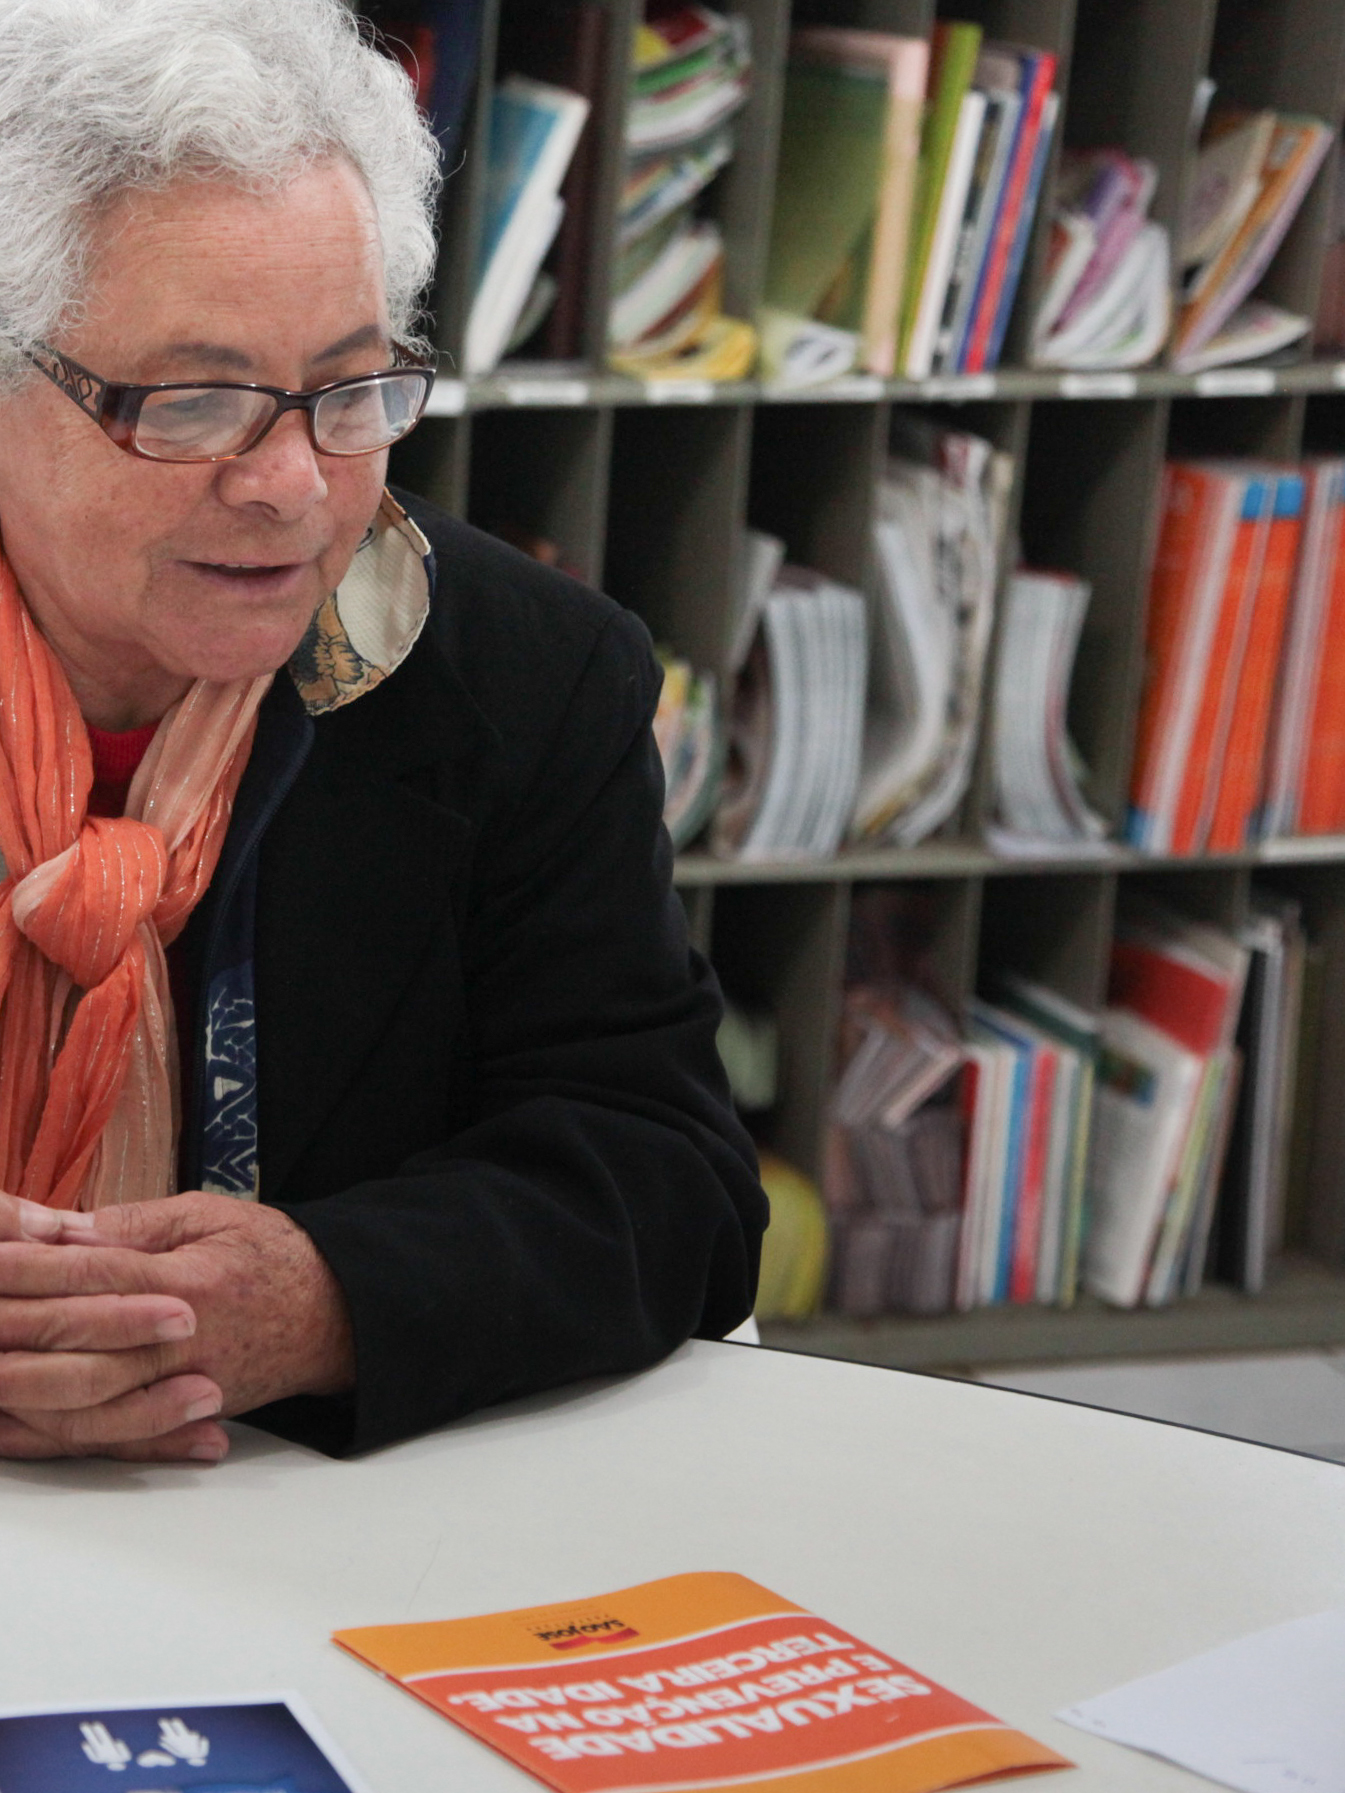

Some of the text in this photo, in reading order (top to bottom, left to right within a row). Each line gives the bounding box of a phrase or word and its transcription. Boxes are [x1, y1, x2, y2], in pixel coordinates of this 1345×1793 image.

[446, 1632, 856, 1712] TERCEIRA IDADE.
[494, 1654, 893, 1734] E PREVENÇÃO NA
[528, 1675, 932, 1761] SEXUALIDADE
